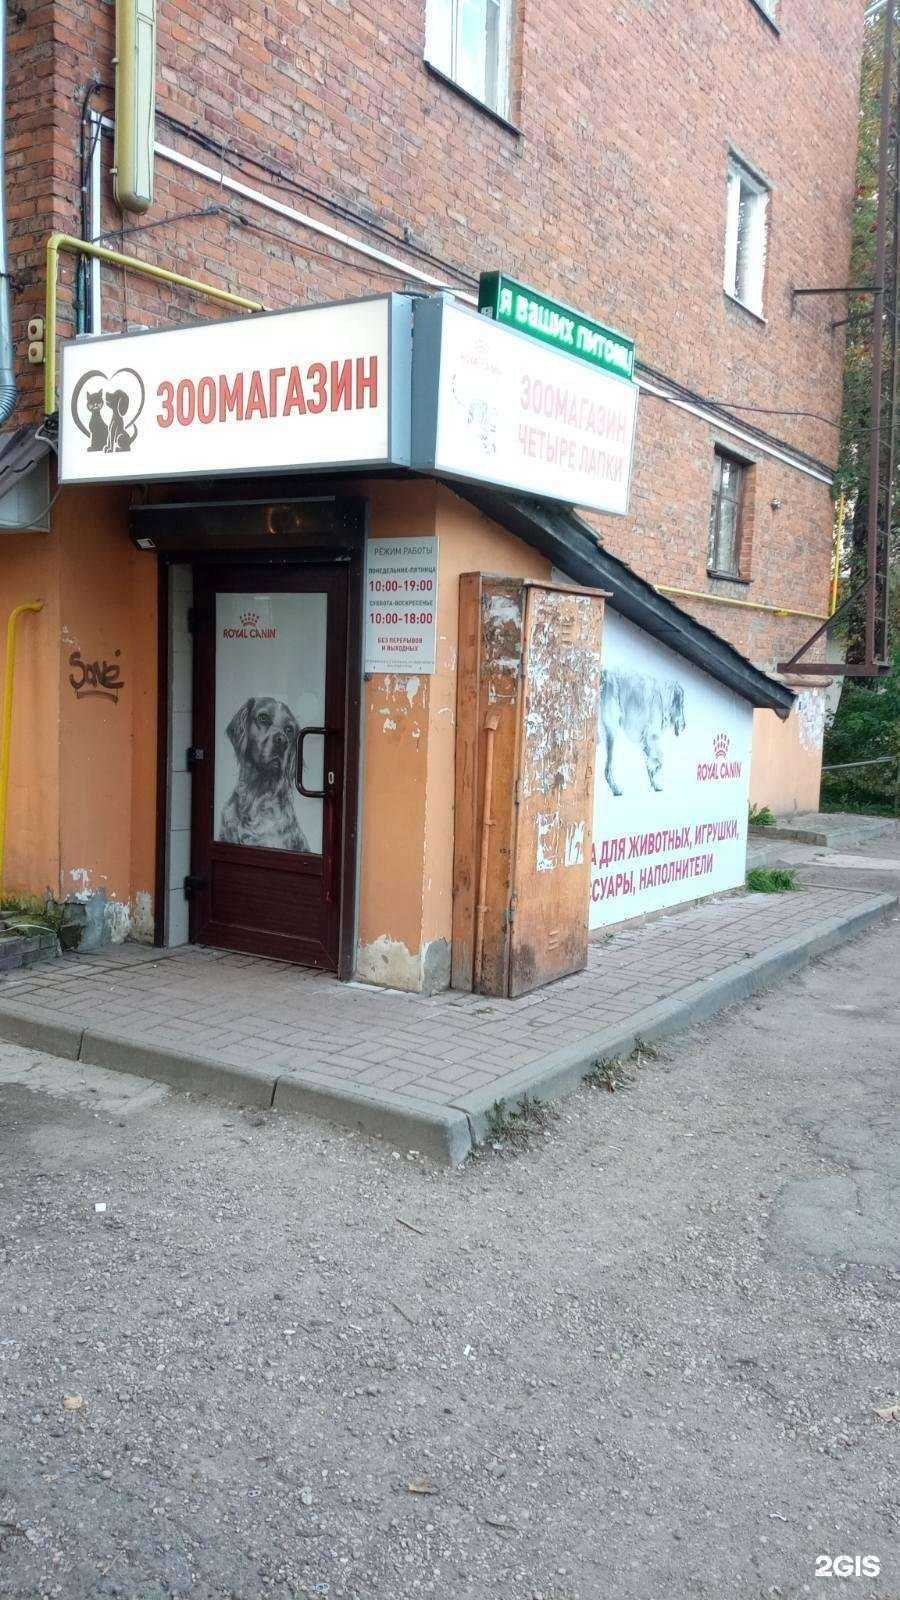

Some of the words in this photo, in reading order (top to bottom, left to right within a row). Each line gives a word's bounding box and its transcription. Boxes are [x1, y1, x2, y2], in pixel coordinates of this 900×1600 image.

[156, 355, 378, 428] ЗООМАГАЗИН
[520, 373, 626, 444] ЗООМАГАЗИН
[518, 424, 576, 472] ЧЕТЫРЕ
[578, 444, 624, 483] ЛАПКИ
[374, 546, 402, 556] РЕЖИМ
[403, 545, 433, 555] РАБОТЫ
[369, 579, 433, 592] 10:00-19:00
[369, 612, 433, 624] 10:00-18:00
[223, 628, 249, 640] ROYAL
[249, 627, 276, 639] CANIN
[377, 636, 389, 644] БЕЗ
[696, 763, 719, 781] ROYAL
[719, 761, 742, 779] CANIN
[599, 837, 626, 870] ДЛЯ
[627, 825, 693, 860] ЖИВОТНЫХ,
[695, 819, 740, 845] ИГРУШКИ,
[589, 870, 636, 903] СУАРЫ,
[639, 853, 714, 890] НАПОЛНИТЕЛИ
